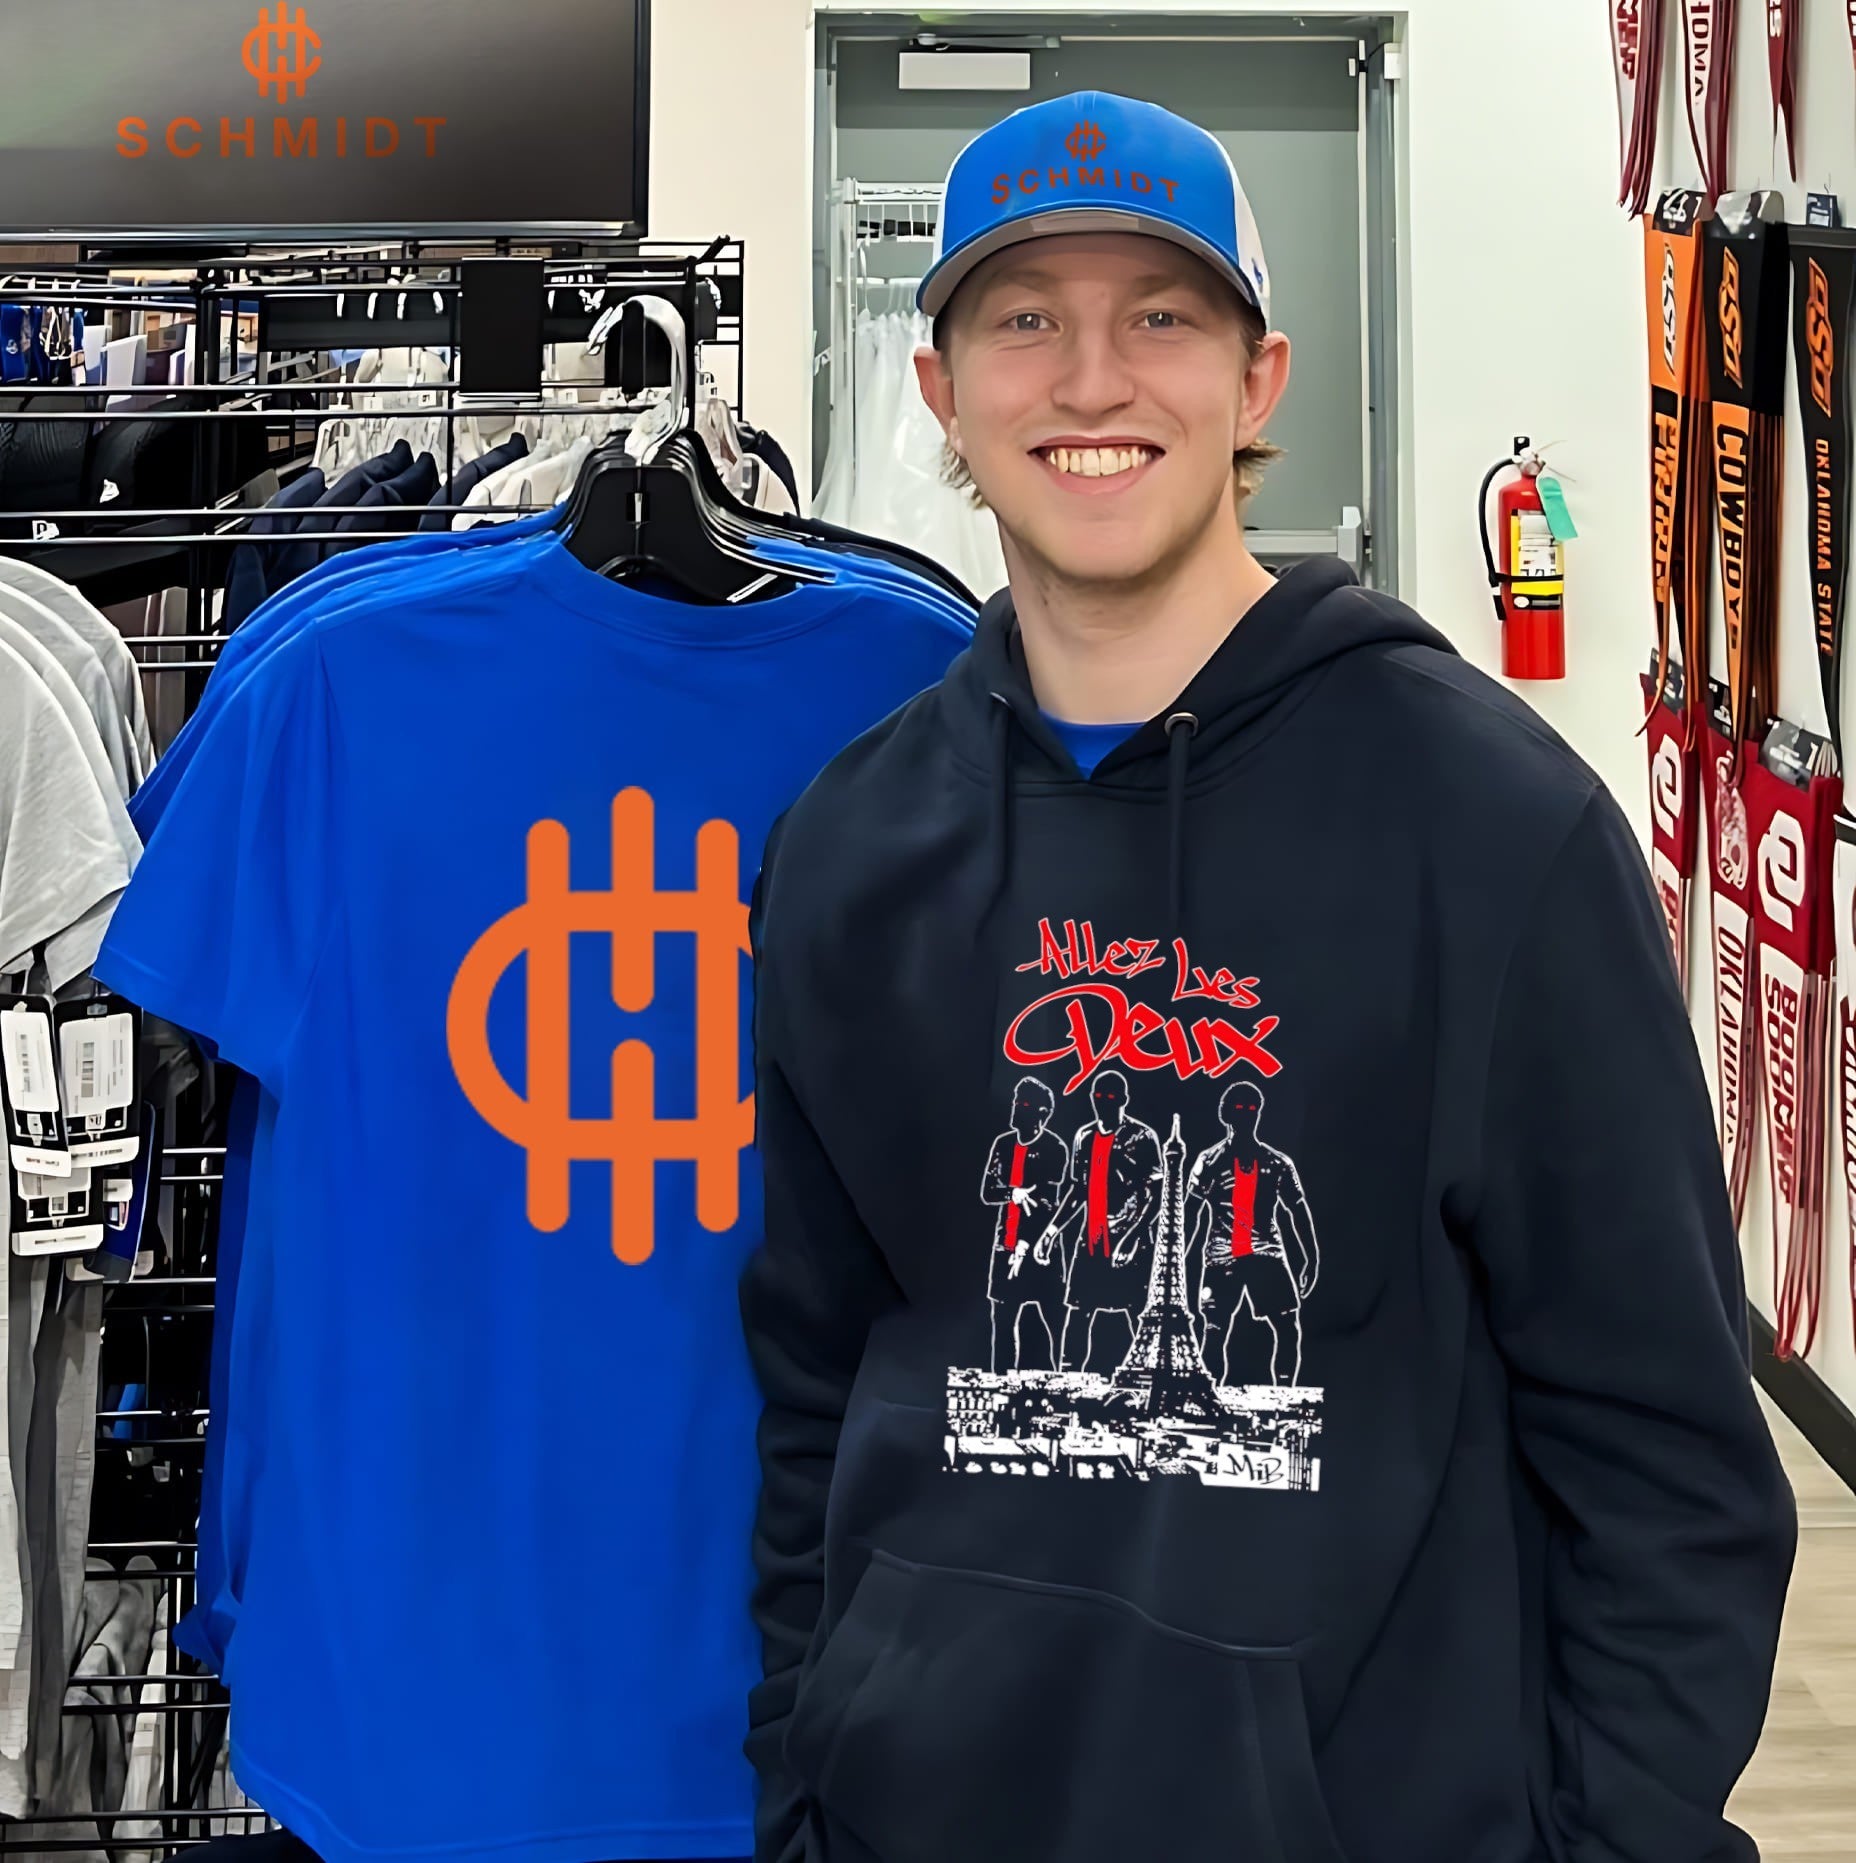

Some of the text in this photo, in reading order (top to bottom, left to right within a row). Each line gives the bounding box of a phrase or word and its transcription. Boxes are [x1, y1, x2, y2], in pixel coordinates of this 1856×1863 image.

[115, 116, 447, 159] SCHMIDT
[991, 167, 1180, 205] SCHMIDT
[1815, 439, 1832, 570] OKLAHOMA
[1014, 917, 1167, 980] Allez
[1003, 982, 1284, 1096] Deux
[1717, 926, 1745, 1145] OKLAHOMA
